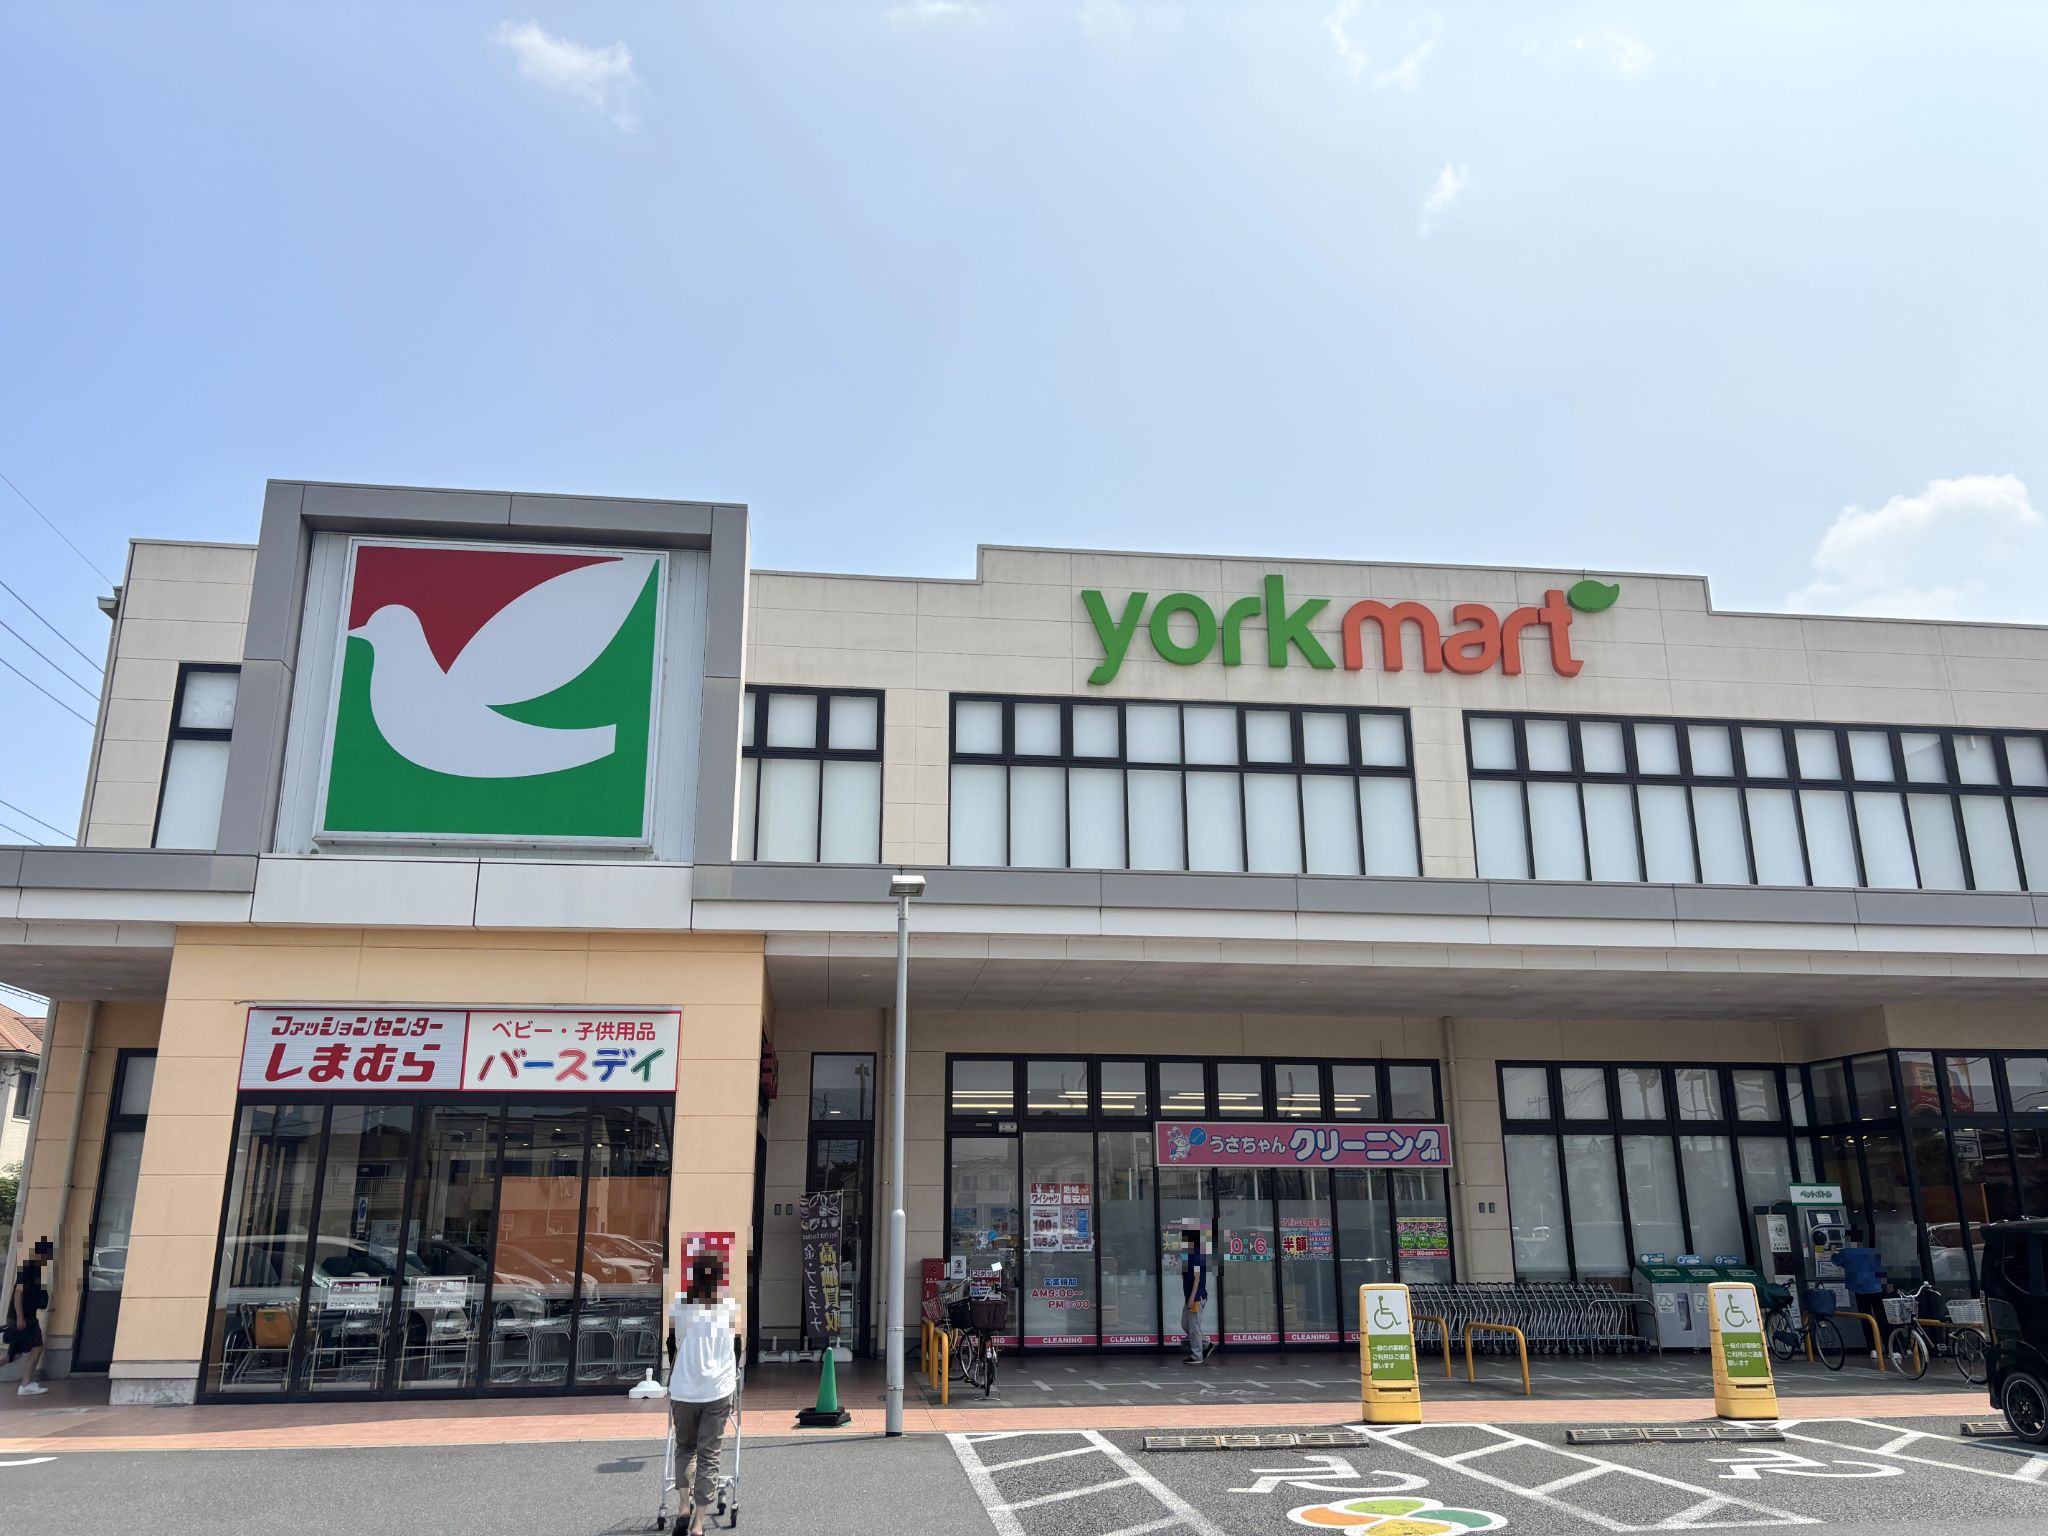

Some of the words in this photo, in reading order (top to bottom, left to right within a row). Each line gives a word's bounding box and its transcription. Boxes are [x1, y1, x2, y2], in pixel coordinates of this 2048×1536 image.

[271, 1016, 444, 1037] ファッションセンター
[492, 1020, 656, 1041] ベビー・子供用品
[264, 1042, 441, 1082] しまむら
[477, 1047, 665, 1083] バースデイ
[1031, 1194, 1060, 1204] ワイシャツ
[1283, 1235, 1308, 1252] 半額
[1043, 1278, 1078, 1287] 営業時間
[1048, 1300, 1090, 1310] PM:00
[1109, 1335, 1150, 1343] CLEANING
[1232, 1334, 1272, 1342] CLEANING
[1291, 1333, 1331, 1341] CLEANING
